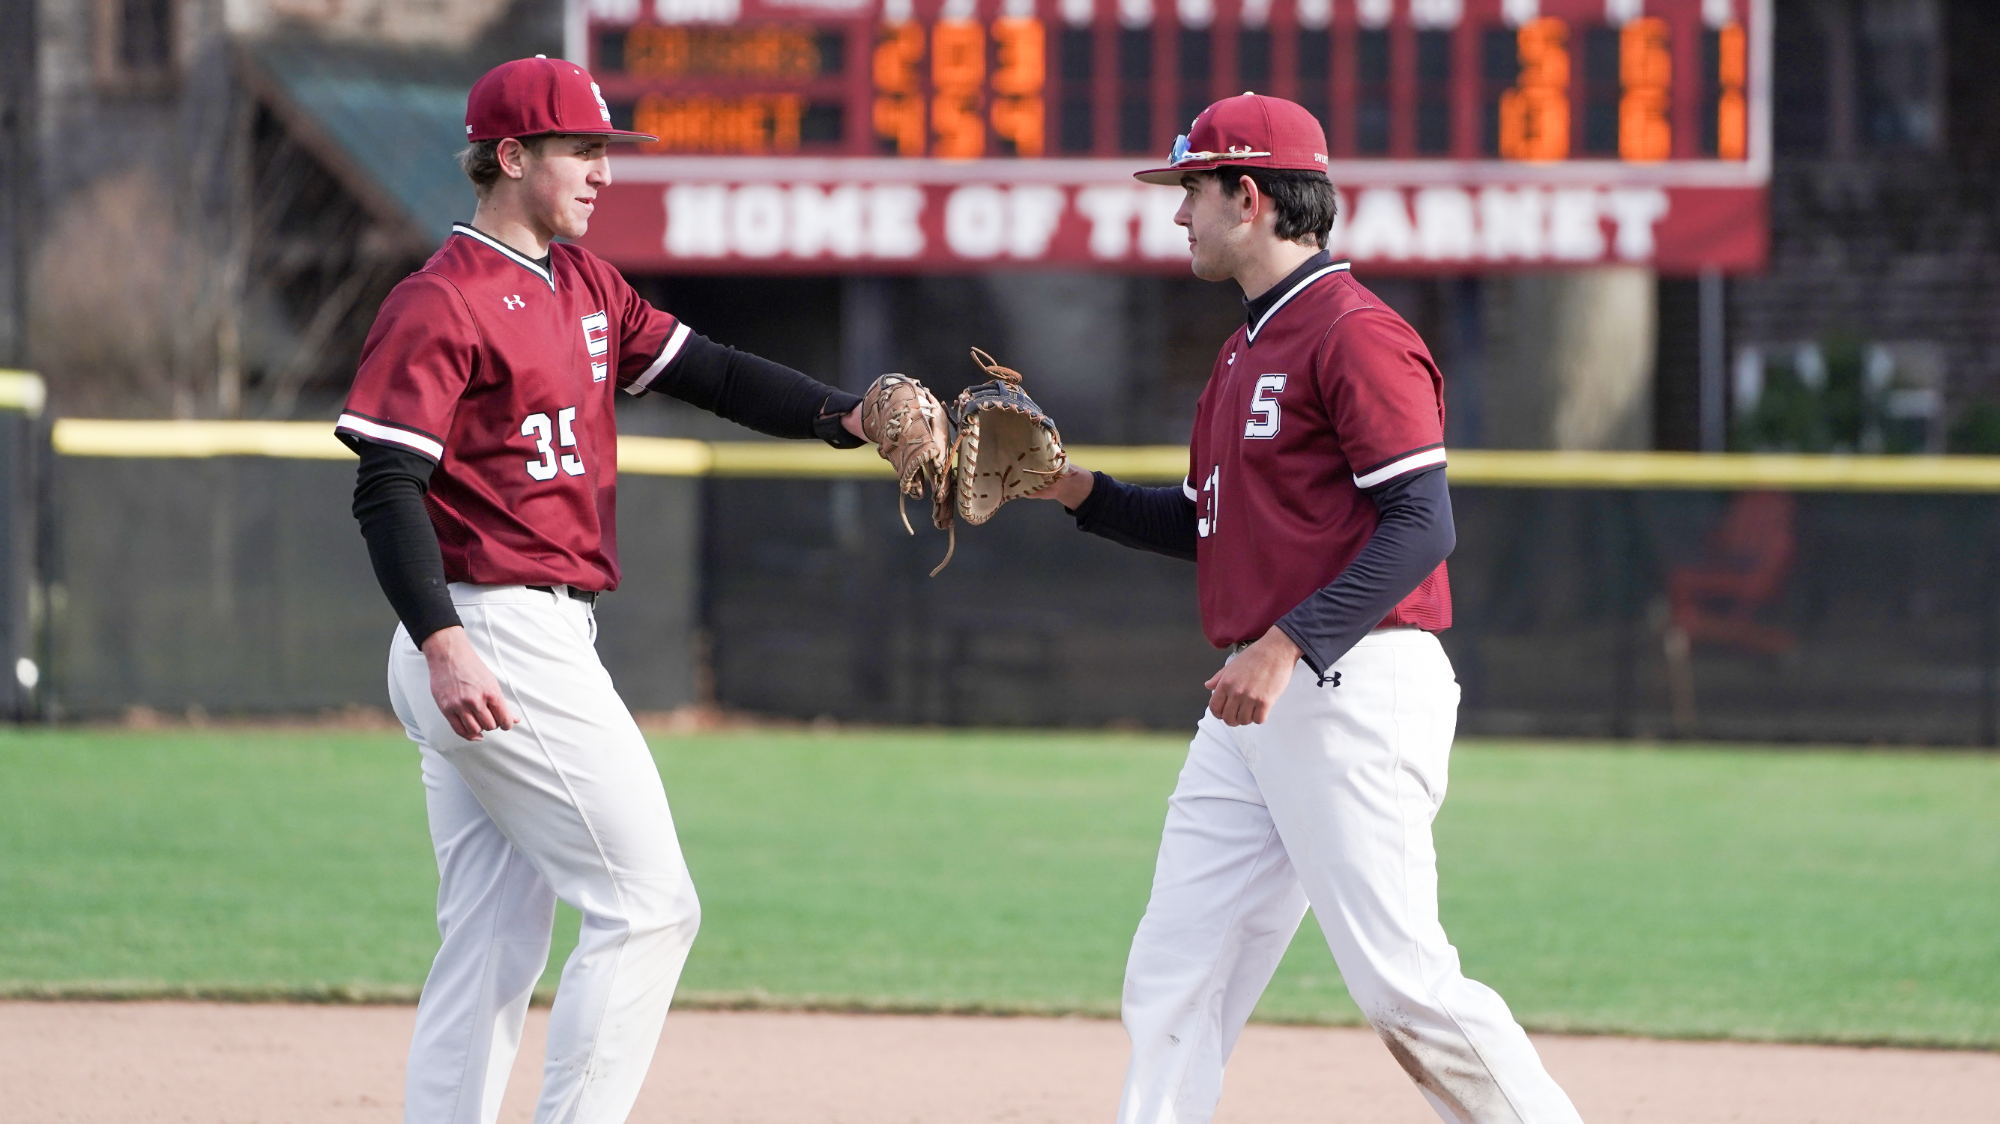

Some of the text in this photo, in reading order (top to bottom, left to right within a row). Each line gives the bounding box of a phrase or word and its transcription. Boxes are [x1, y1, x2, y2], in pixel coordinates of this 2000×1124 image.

[874, 20, 925, 91] 2
[932, 17, 985, 91] 0
[991, 17, 1046, 92] 3
[1518, 17, 1570, 88] 5
[1719, 22, 1745, 87] 1
[591, 82, 610, 121] S
[1719, 90, 1745, 160] 1
[664, 184, 924, 258] HOME
[944, 184, 1065, 258] OF
[1332, 187, 1669, 260] ARNET
[521, 406, 586, 481] 35
[1243, 373, 1287, 440] S
[1197, 463, 1219, 538] 31
